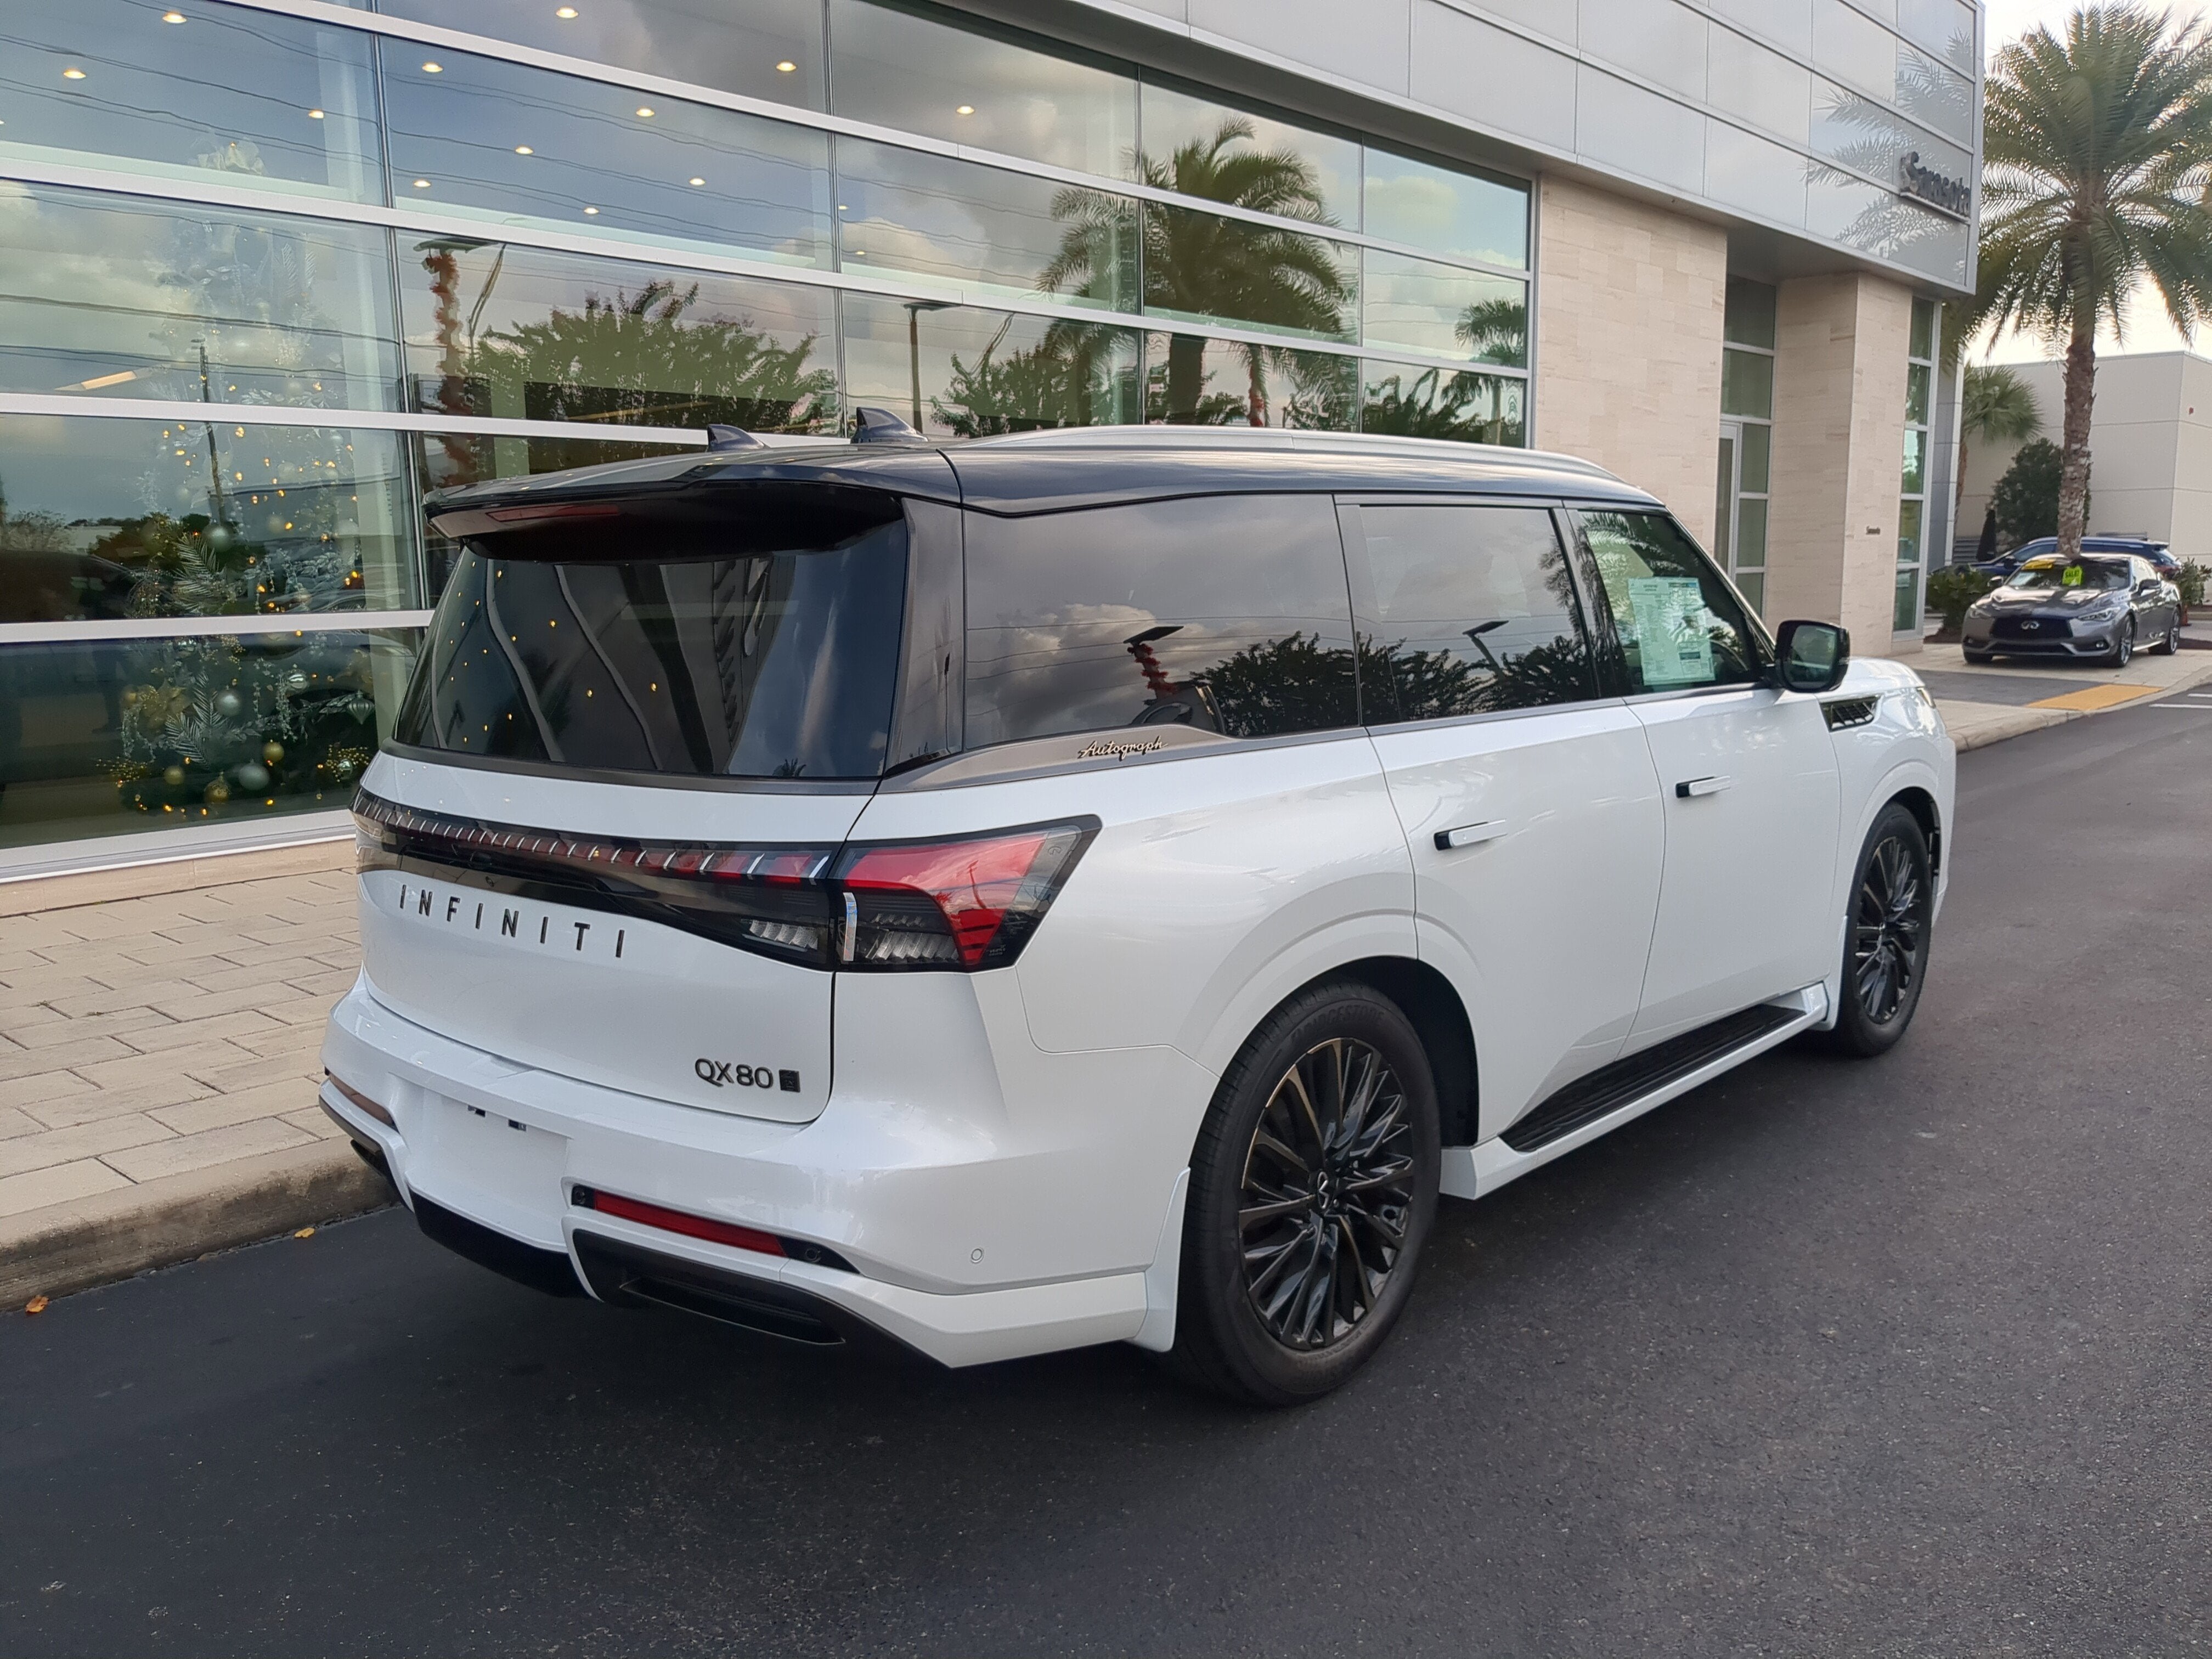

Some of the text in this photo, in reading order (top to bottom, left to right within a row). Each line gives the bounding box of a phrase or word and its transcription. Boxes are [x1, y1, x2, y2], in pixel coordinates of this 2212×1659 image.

[1078, 735, 1168, 761] Autograph
[399, 884, 625, 958] INFINITI
[695, 1058, 774, 1088] QX80
